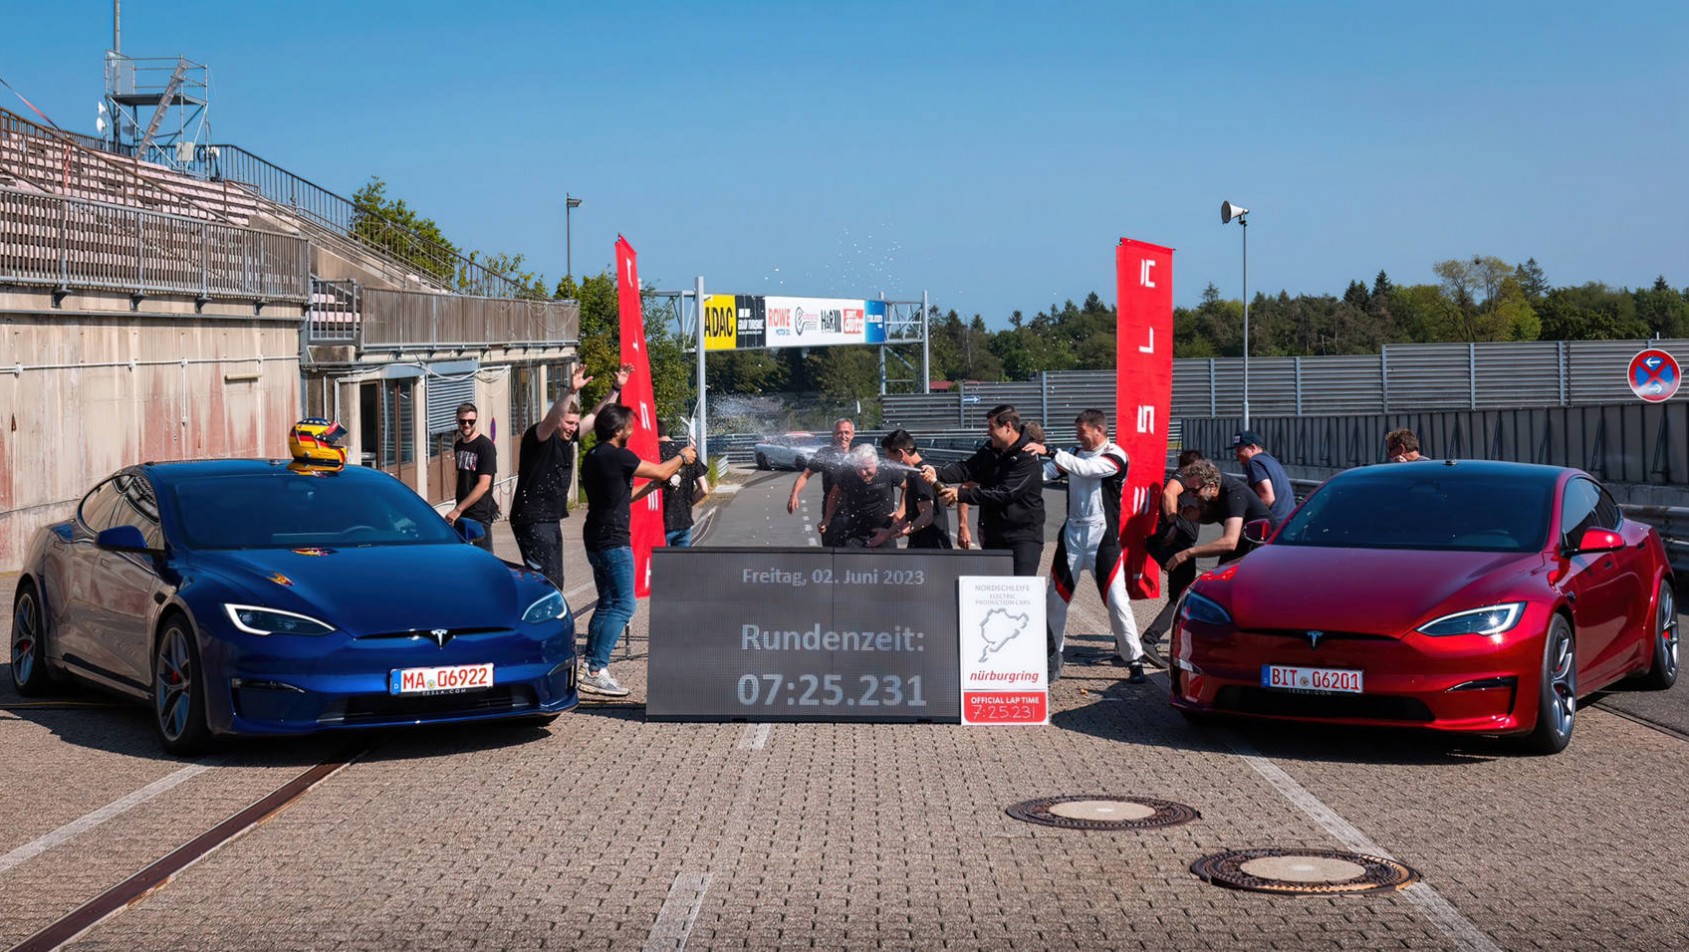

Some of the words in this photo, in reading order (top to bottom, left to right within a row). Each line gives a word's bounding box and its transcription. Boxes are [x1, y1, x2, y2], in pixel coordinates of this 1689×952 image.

[704, 306, 733, 338] ADAC
[767, 308, 791, 328] ROWE
[742, 567, 807, 587] Freitag,
[811, 568, 839, 584] 02.
[843, 568, 878, 585] Juni
[883, 569, 925, 585] 2023
[741, 622, 925, 652] Rundenzeit:
[403, 671, 425, 690] MA
[437, 667, 488, 687] 06922
[969, 669, 1040, 684] nürburgring
[1271, 668, 1297, 686] BIT
[1312, 671, 1360, 690] 06201
[737, 673, 927, 706] 07:25.231
[970, 696, 1004, 704] OFFICIAL
[1006, 696, 1020, 704] LAP
[1021, 696, 1040, 704] TIME
[971, 704, 1036, 720] 7:25.231
